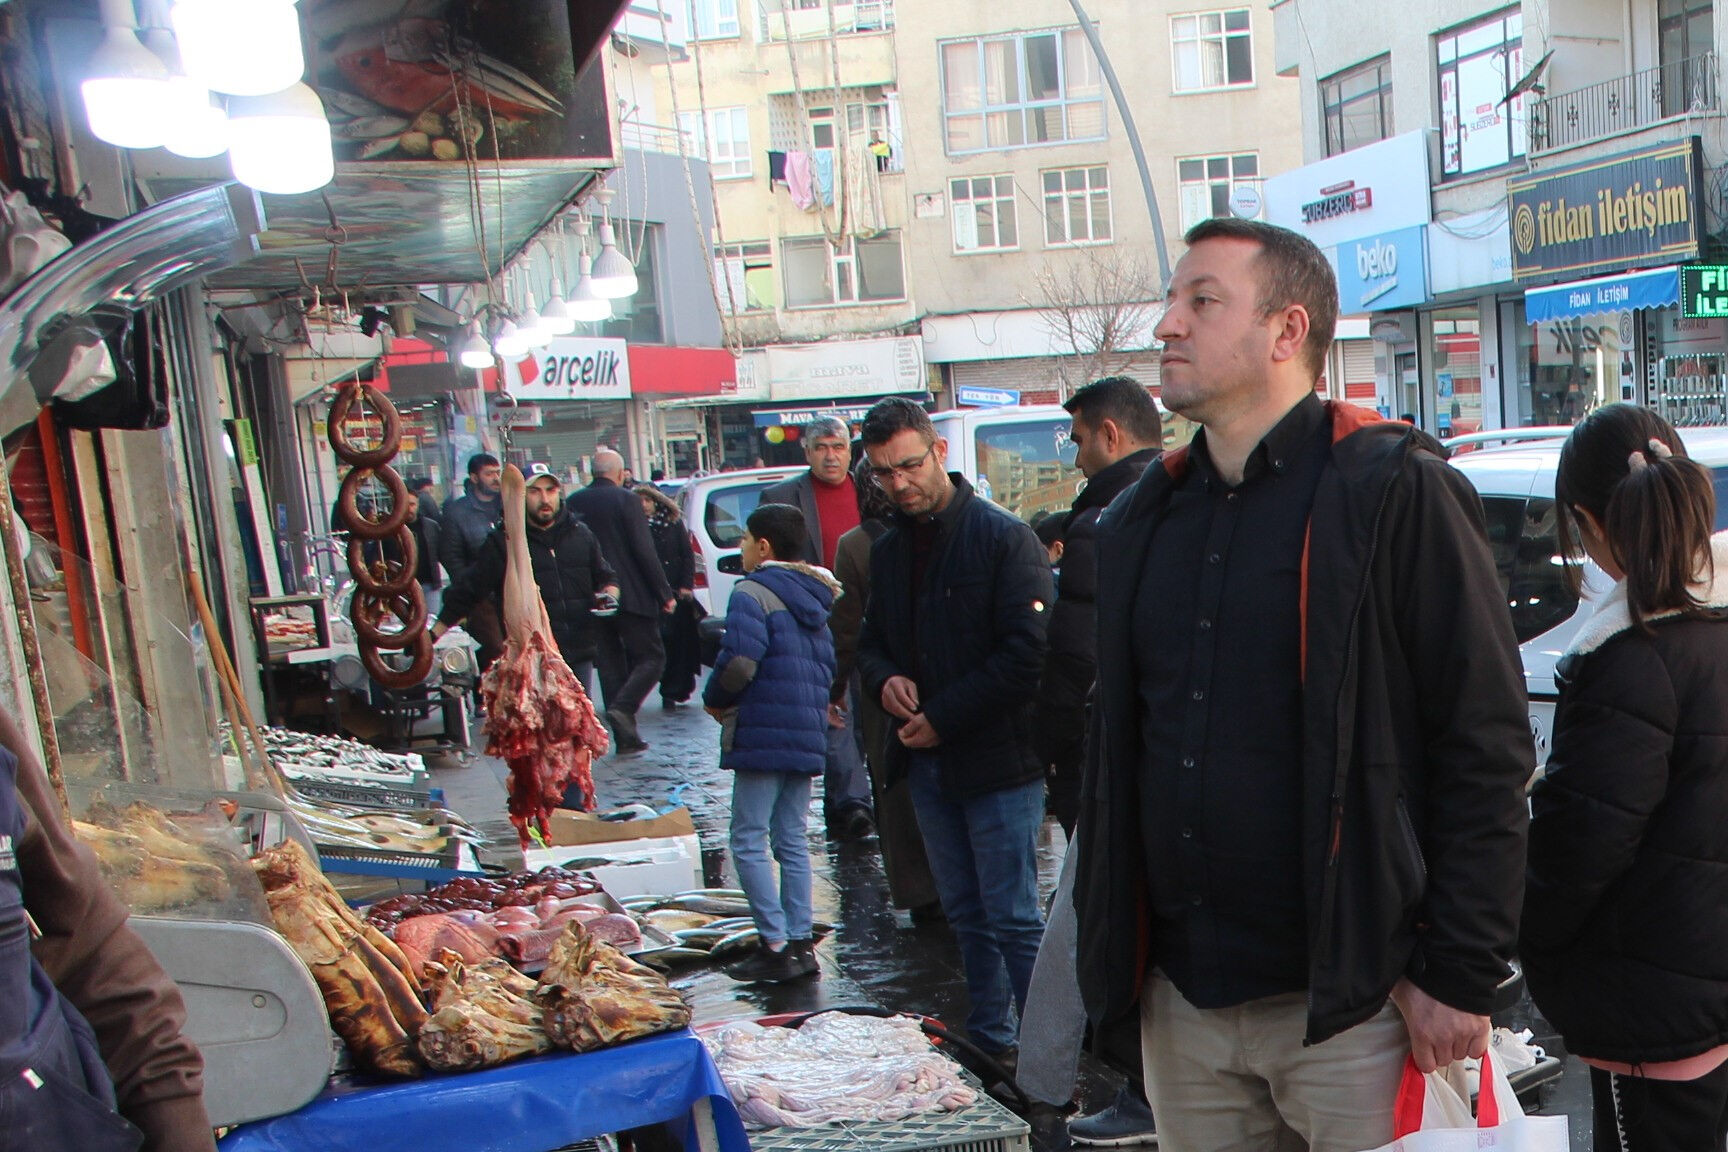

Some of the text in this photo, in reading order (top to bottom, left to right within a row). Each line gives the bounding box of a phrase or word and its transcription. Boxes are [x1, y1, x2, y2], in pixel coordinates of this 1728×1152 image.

[1537, 178, 1688, 247] fidan iletişim
[1356, 238, 1397, 280] beko
[1569, 282, 1629, 309] FİDAN İLETİŞİM
[543, 351, 620, 395] arçelik
[779, 412, 814, 425] MAVA
